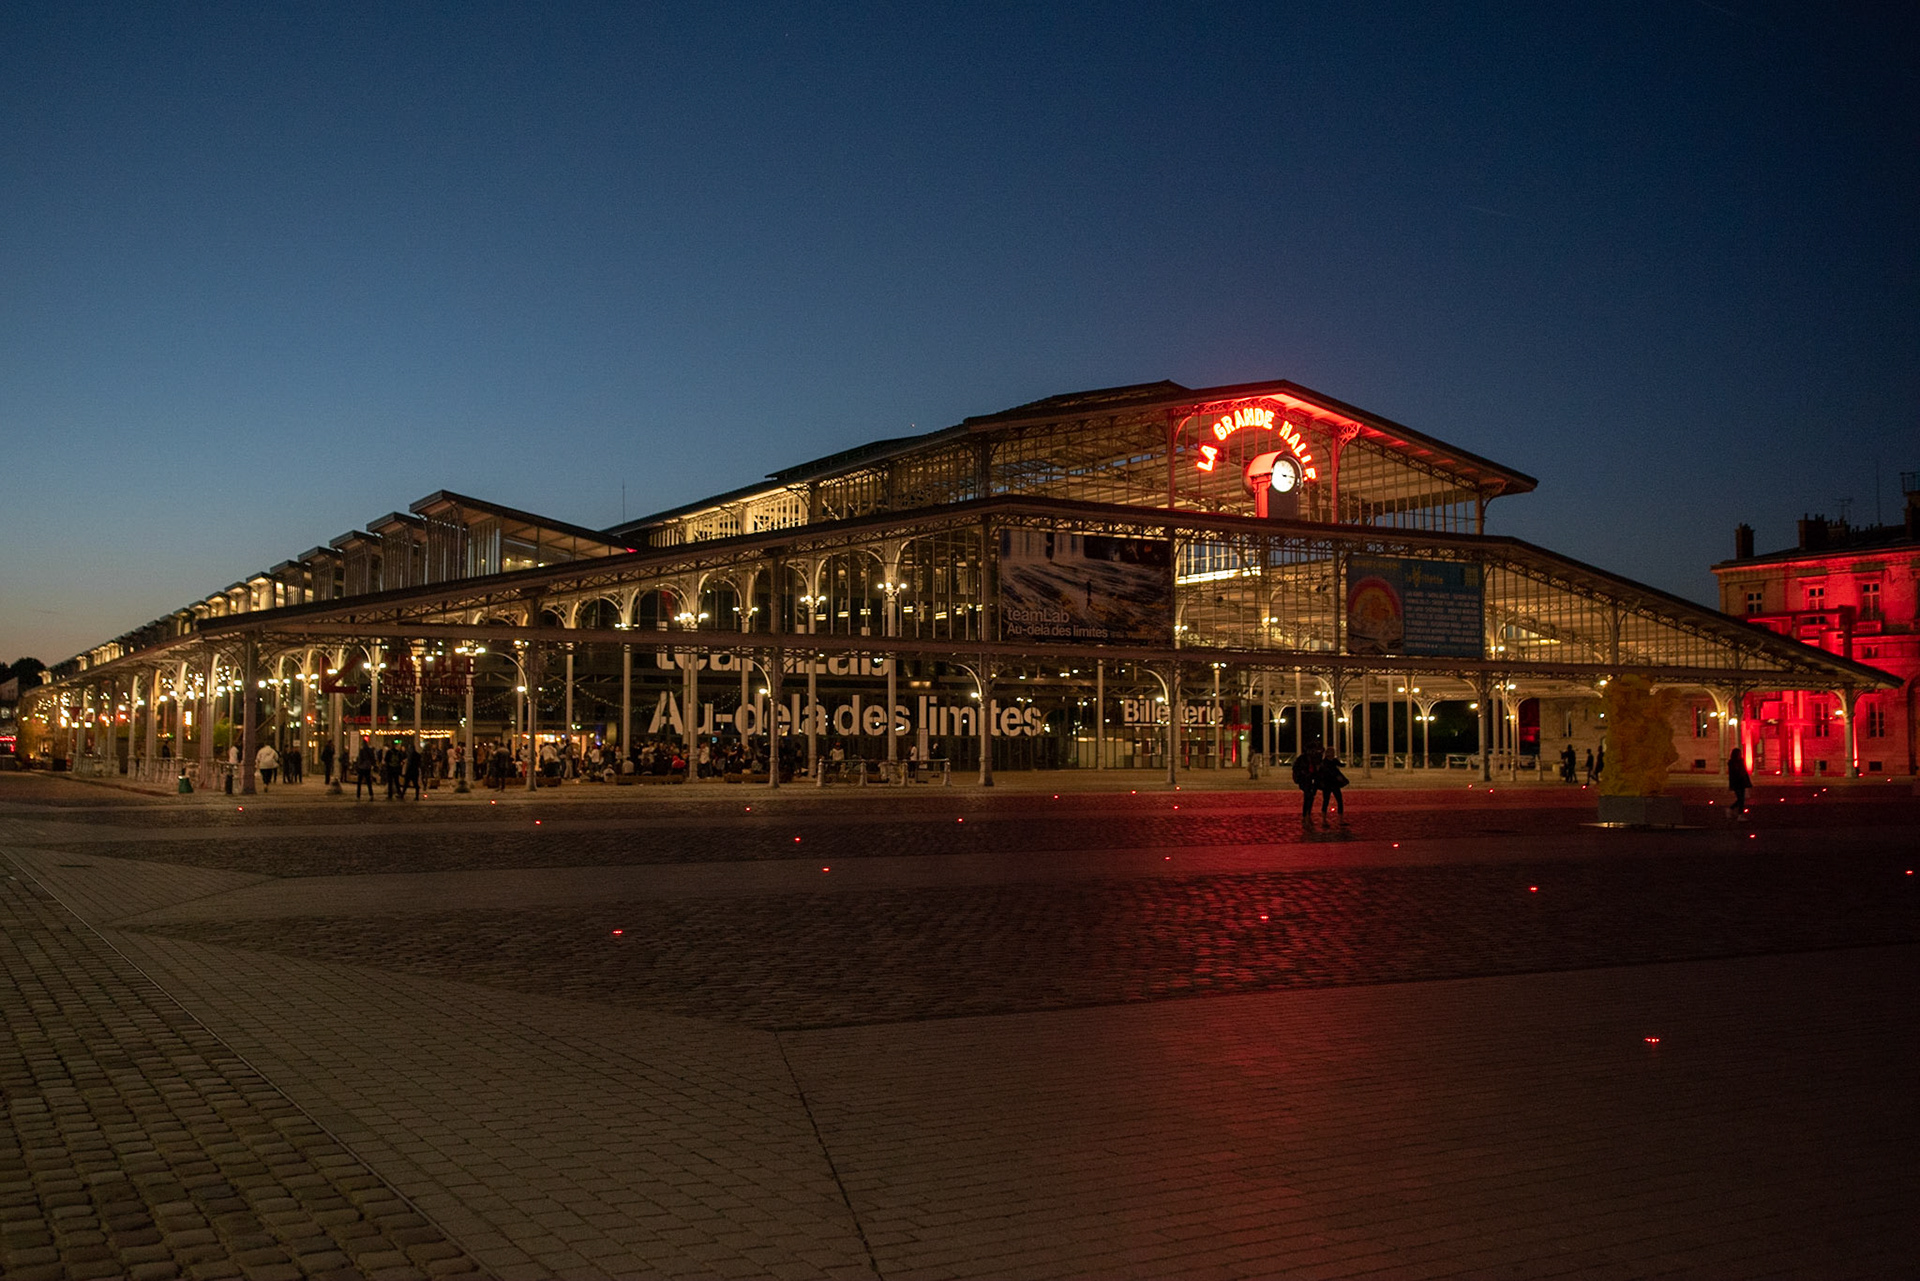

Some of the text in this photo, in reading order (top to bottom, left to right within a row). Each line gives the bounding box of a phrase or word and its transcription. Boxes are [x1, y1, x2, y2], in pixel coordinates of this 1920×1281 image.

[1196, 445, 1218, 472] LA
[1213, 407, 1275, 441] GRANDE
[1007, 607, 1070, 623] teamLab
[1051, 625, 1072, 637] des
[1073, 624, 1109, 639] limites
[833, 694, 911, 737] des
[918, 695, 1042, 737] limtes
[1124, 698, 1224, 723] Billeterie
